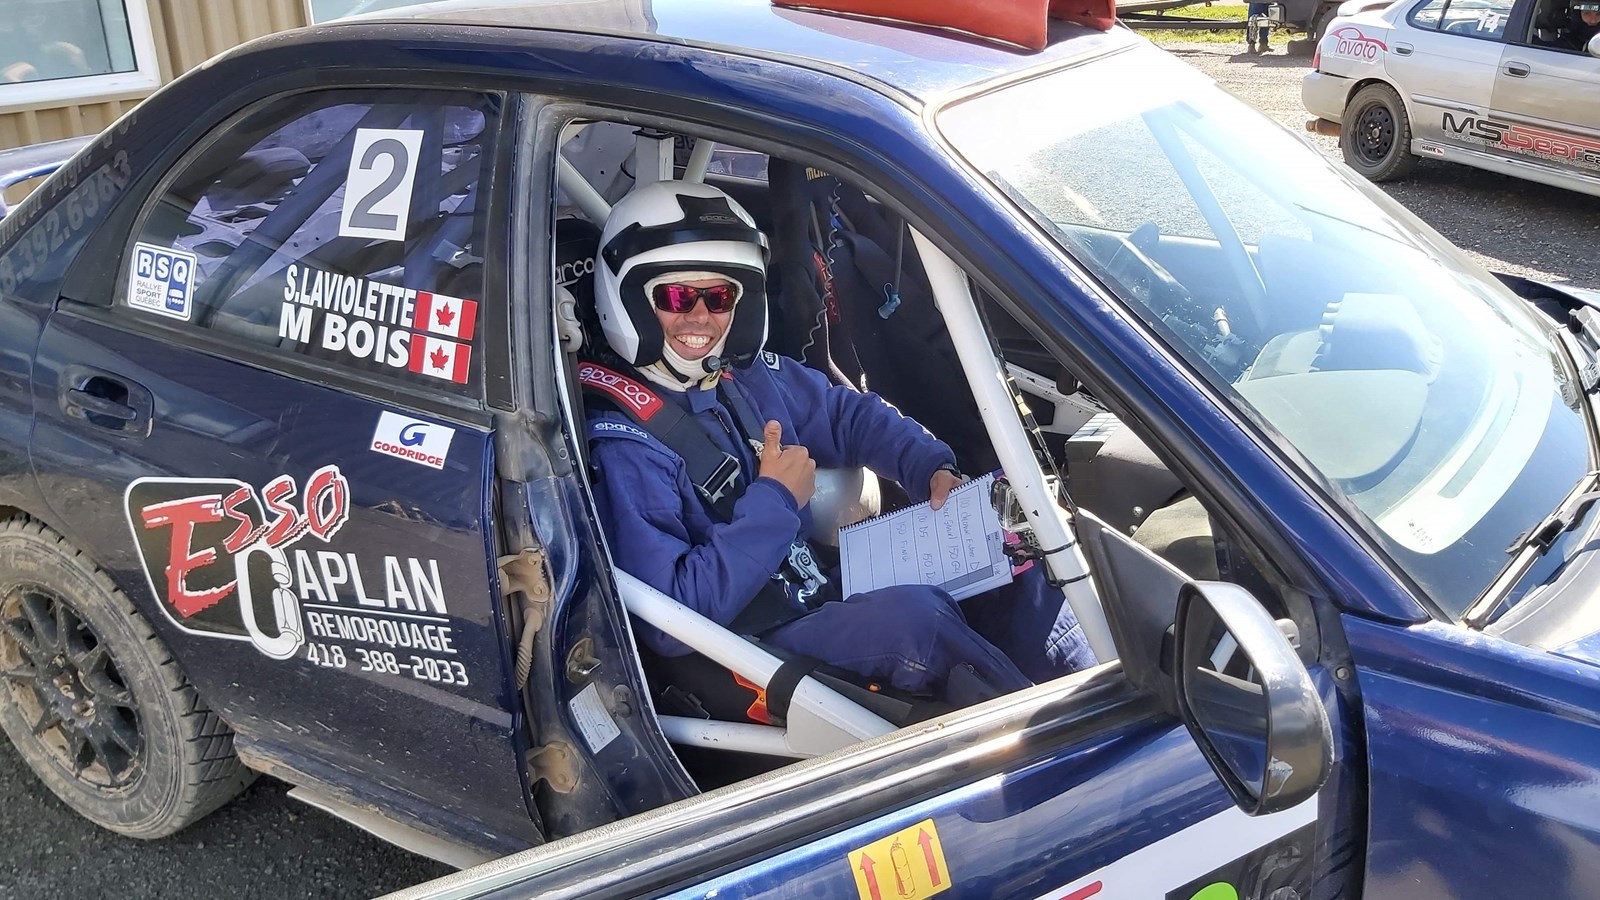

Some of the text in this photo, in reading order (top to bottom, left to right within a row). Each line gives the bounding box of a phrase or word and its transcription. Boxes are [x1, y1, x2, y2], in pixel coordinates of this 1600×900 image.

[348, 138, 409, 231] 2
[137, 280, 162, 292] RALLYE
[139, 252, 187, 284] RSQ
[137, 288, 161, 299] SPORT
[284, 264, 416, 328] S.LAVIOLETTE
[279, 302, 411, 368] M BOIS
[580, 366, 650, 405] sparco
[595, 422, 649, 440] sparco
[374, 441, 443, 466] GOODRIDGE
[307, 611, 457, 653] REMORQUAGE
[307, 642, 469, 687] 418 388-2033
